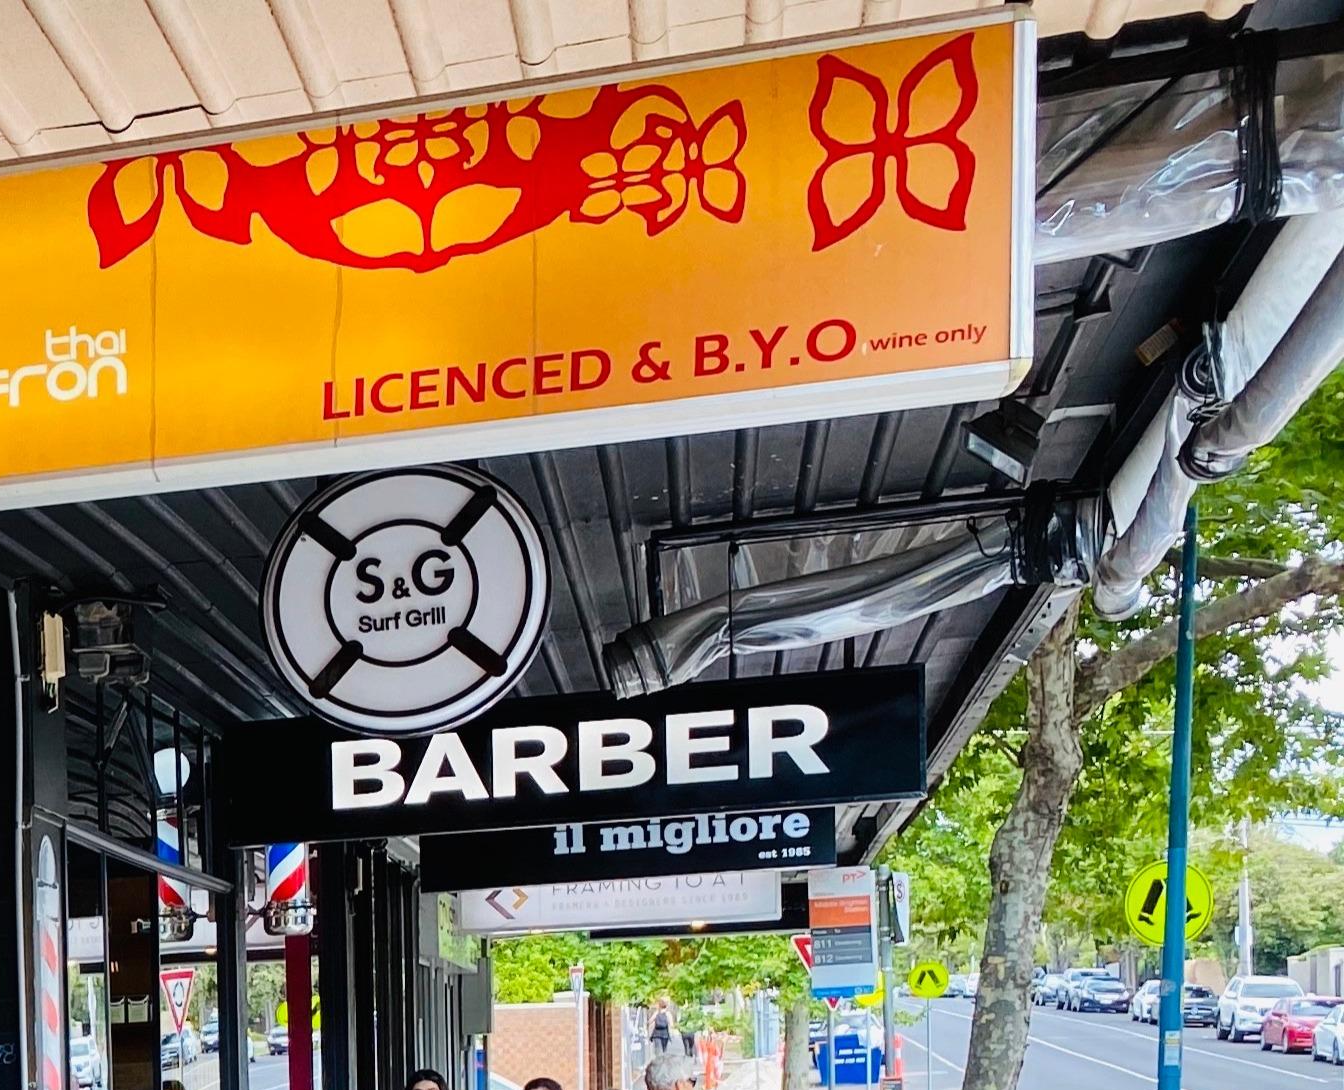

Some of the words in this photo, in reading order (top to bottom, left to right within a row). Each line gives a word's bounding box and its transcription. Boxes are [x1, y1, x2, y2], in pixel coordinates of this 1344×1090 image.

[45, 326, 127, 363] thai
[322, 348, 611, 420] LICENCED
[631, 341, 672, 385] &
[694, 318, 858, 377] B.Y.O
[870, 333, 928, 352] wine
[935, 323, 988, 348] only
[358, 611, 401, 633] Surf
[405, 606, 446, 627] Grill
[331, 704, 830, 810] BARBER
[553, 822, 586, 855] il
[600, 812, 810, 855] migliore
